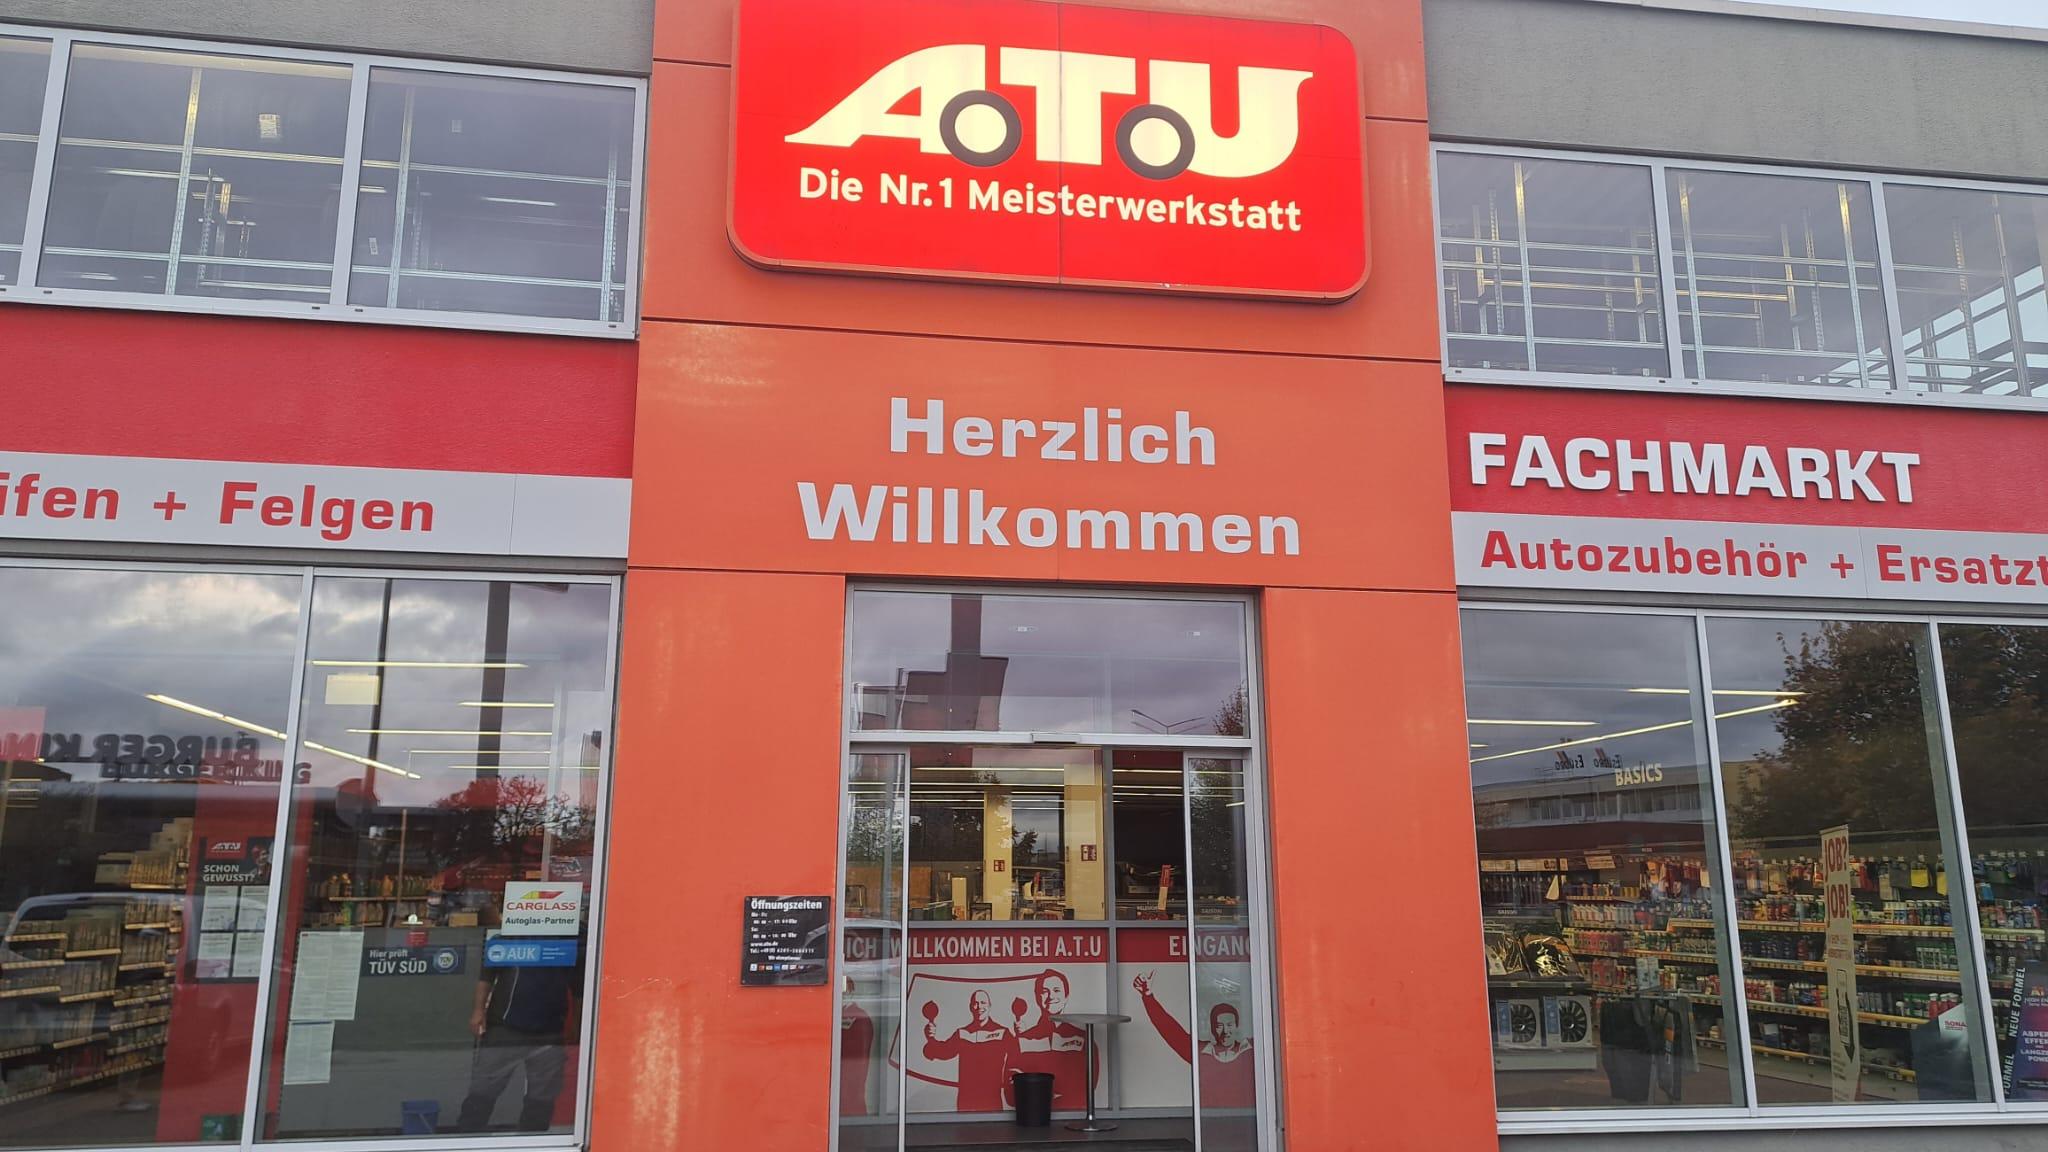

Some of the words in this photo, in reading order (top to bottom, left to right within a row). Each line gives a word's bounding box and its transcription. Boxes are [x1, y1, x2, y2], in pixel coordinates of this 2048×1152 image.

[784, 44, 1313, 181] ATU
[799, 166, 864, 202] Die
[969, 179, 1303, 232] Meisterwerkstatt
[890, 397, 1216, 466] Herzlich
[1468, 431, 1921, 504] FACHMARKT
[219, 480, 435, 542] Felgen
[796, 481, 1300, 556] Willkommen
[1480, 530, 1808, 580] Autozubehör
[1615, 763, 1663, 786] BASICS
[203, 864, 240, 873] SCHON
[1824, 836, 1848, 884] JOB?
[202, 873, 256, 883] GEWUSST?
[506, 902, 577, 911] CARGLASS
[751, 898, 823, 912] Öffnungszeiten
[1826, 884, 1850, 928] JOB!
[505, 917, 575, 926] Autoglas-Partner
[369, 949, 387, 958] Hier
[507, 947, 536, 960] AUK
[890, 936, 1014, 957] WILLKOMMEN
[1020, 936, 1049, 956] BEI
[1055, 935, 1101, 956] A.T.U
[369, 958, 396, 974] TÜV
[399, 957, 428, 974] SÜD
[2013, 967, 2026, 1008] FORMEL
[1945, 1019, 1968, 1027] SONA
[2008, 1010, 2021, 1038] NEUE
